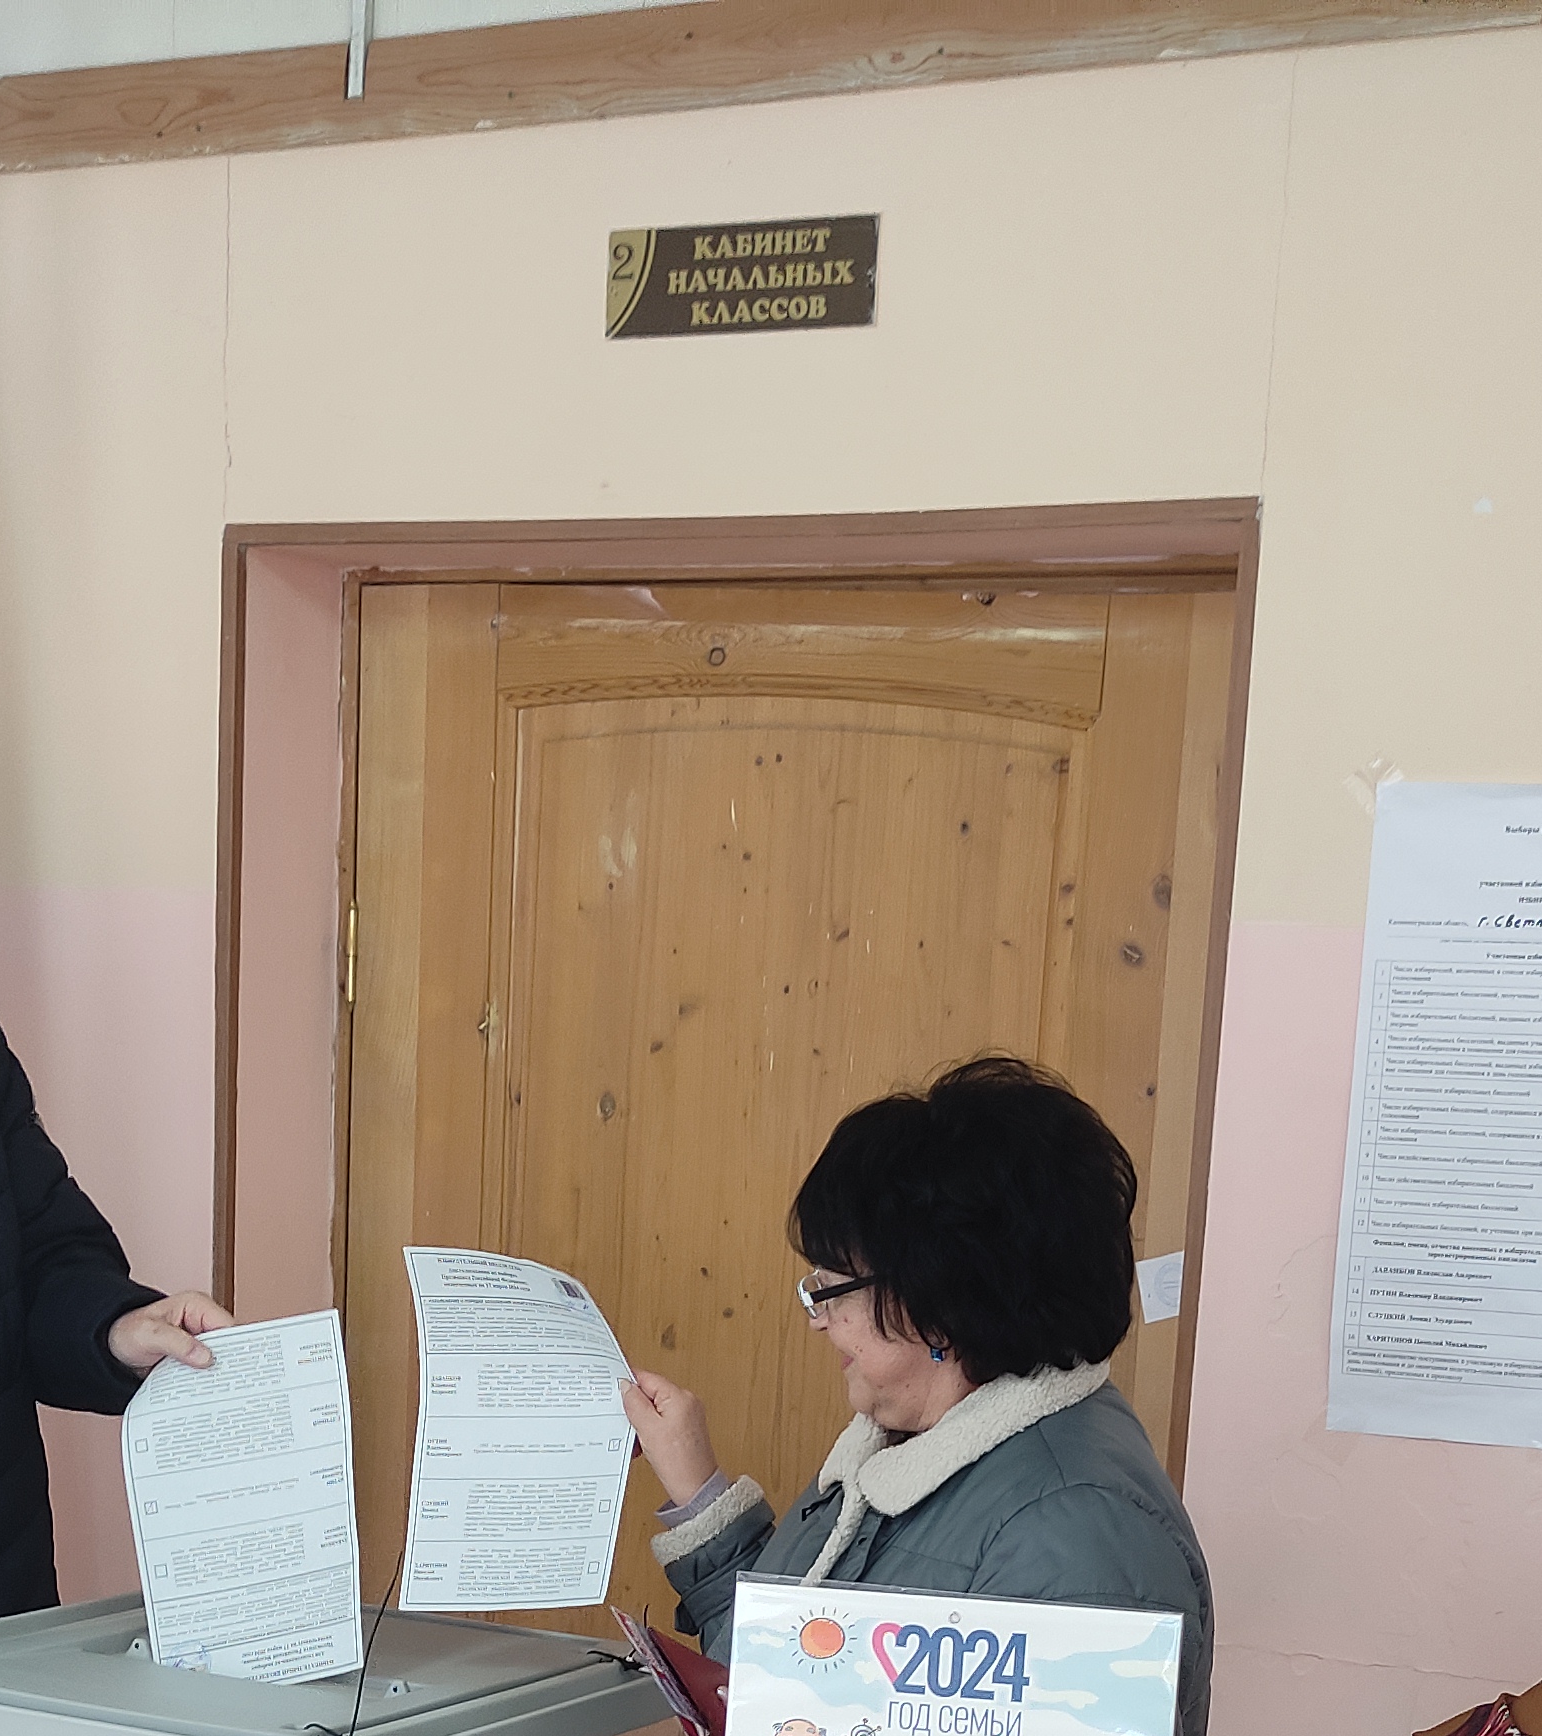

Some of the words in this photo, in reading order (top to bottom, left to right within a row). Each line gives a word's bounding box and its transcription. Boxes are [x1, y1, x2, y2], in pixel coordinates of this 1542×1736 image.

[611, 243, 634, 281] 2
[693, 227, 832, 261] КАБИНЕТ
[666, 258, 856, 296] НАЧАЛЬНЫХ
[689, 294, 828, 327] КЛАССОВ
[894, 1623, 1031, 1703] 2024
